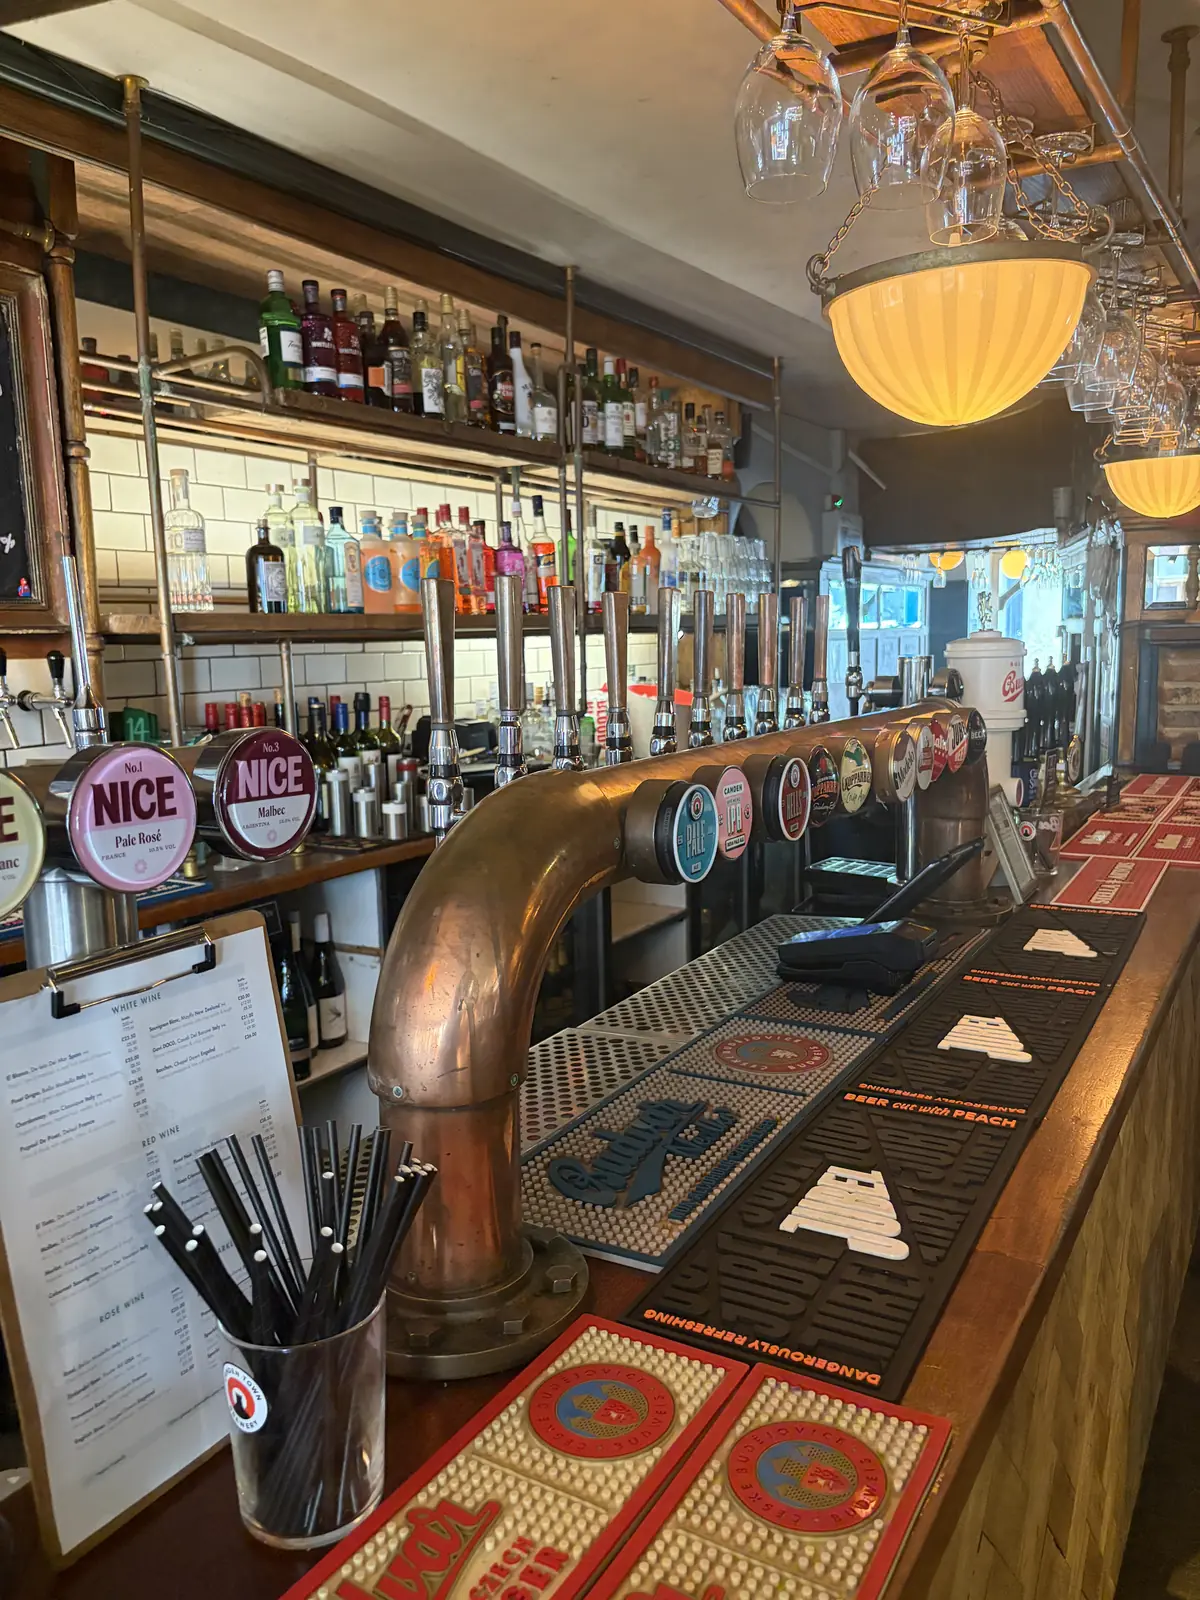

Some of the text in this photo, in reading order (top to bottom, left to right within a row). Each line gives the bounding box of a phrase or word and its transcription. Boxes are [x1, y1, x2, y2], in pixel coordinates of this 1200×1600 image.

[263, 742, 280, 753] No.3
[235, 755, 304, 799] NICE
[90, 775, 178, 826] NICE
[724, 784, 743, 795] CAMDEN
[258, 806, 286, 819] Malbec
[726, 803, 743, 836] IPA
[115, 829, 162, 849] Pale Rosé
[686, 820, 705, 860] PALE
[101, 852, 127, 861] FRANCE
[963, 975, 998, 985] BEER
[1047, 985, 1097, 996] PEACH
[111, 992, 161, 1014] WHITE WINE
[844, 1092, 1017, 1129] BEER cut with PEACH
[141, 1125, 180, 1148] RED WINE
[124, 1292, 145, 1309] WINE
[643, 1308, 881, 1386] DANGEROUSLY REFRESHING
[243, 1376, 262, 1401] TOWN
[469, 1536, 534, 1600] CZECH
